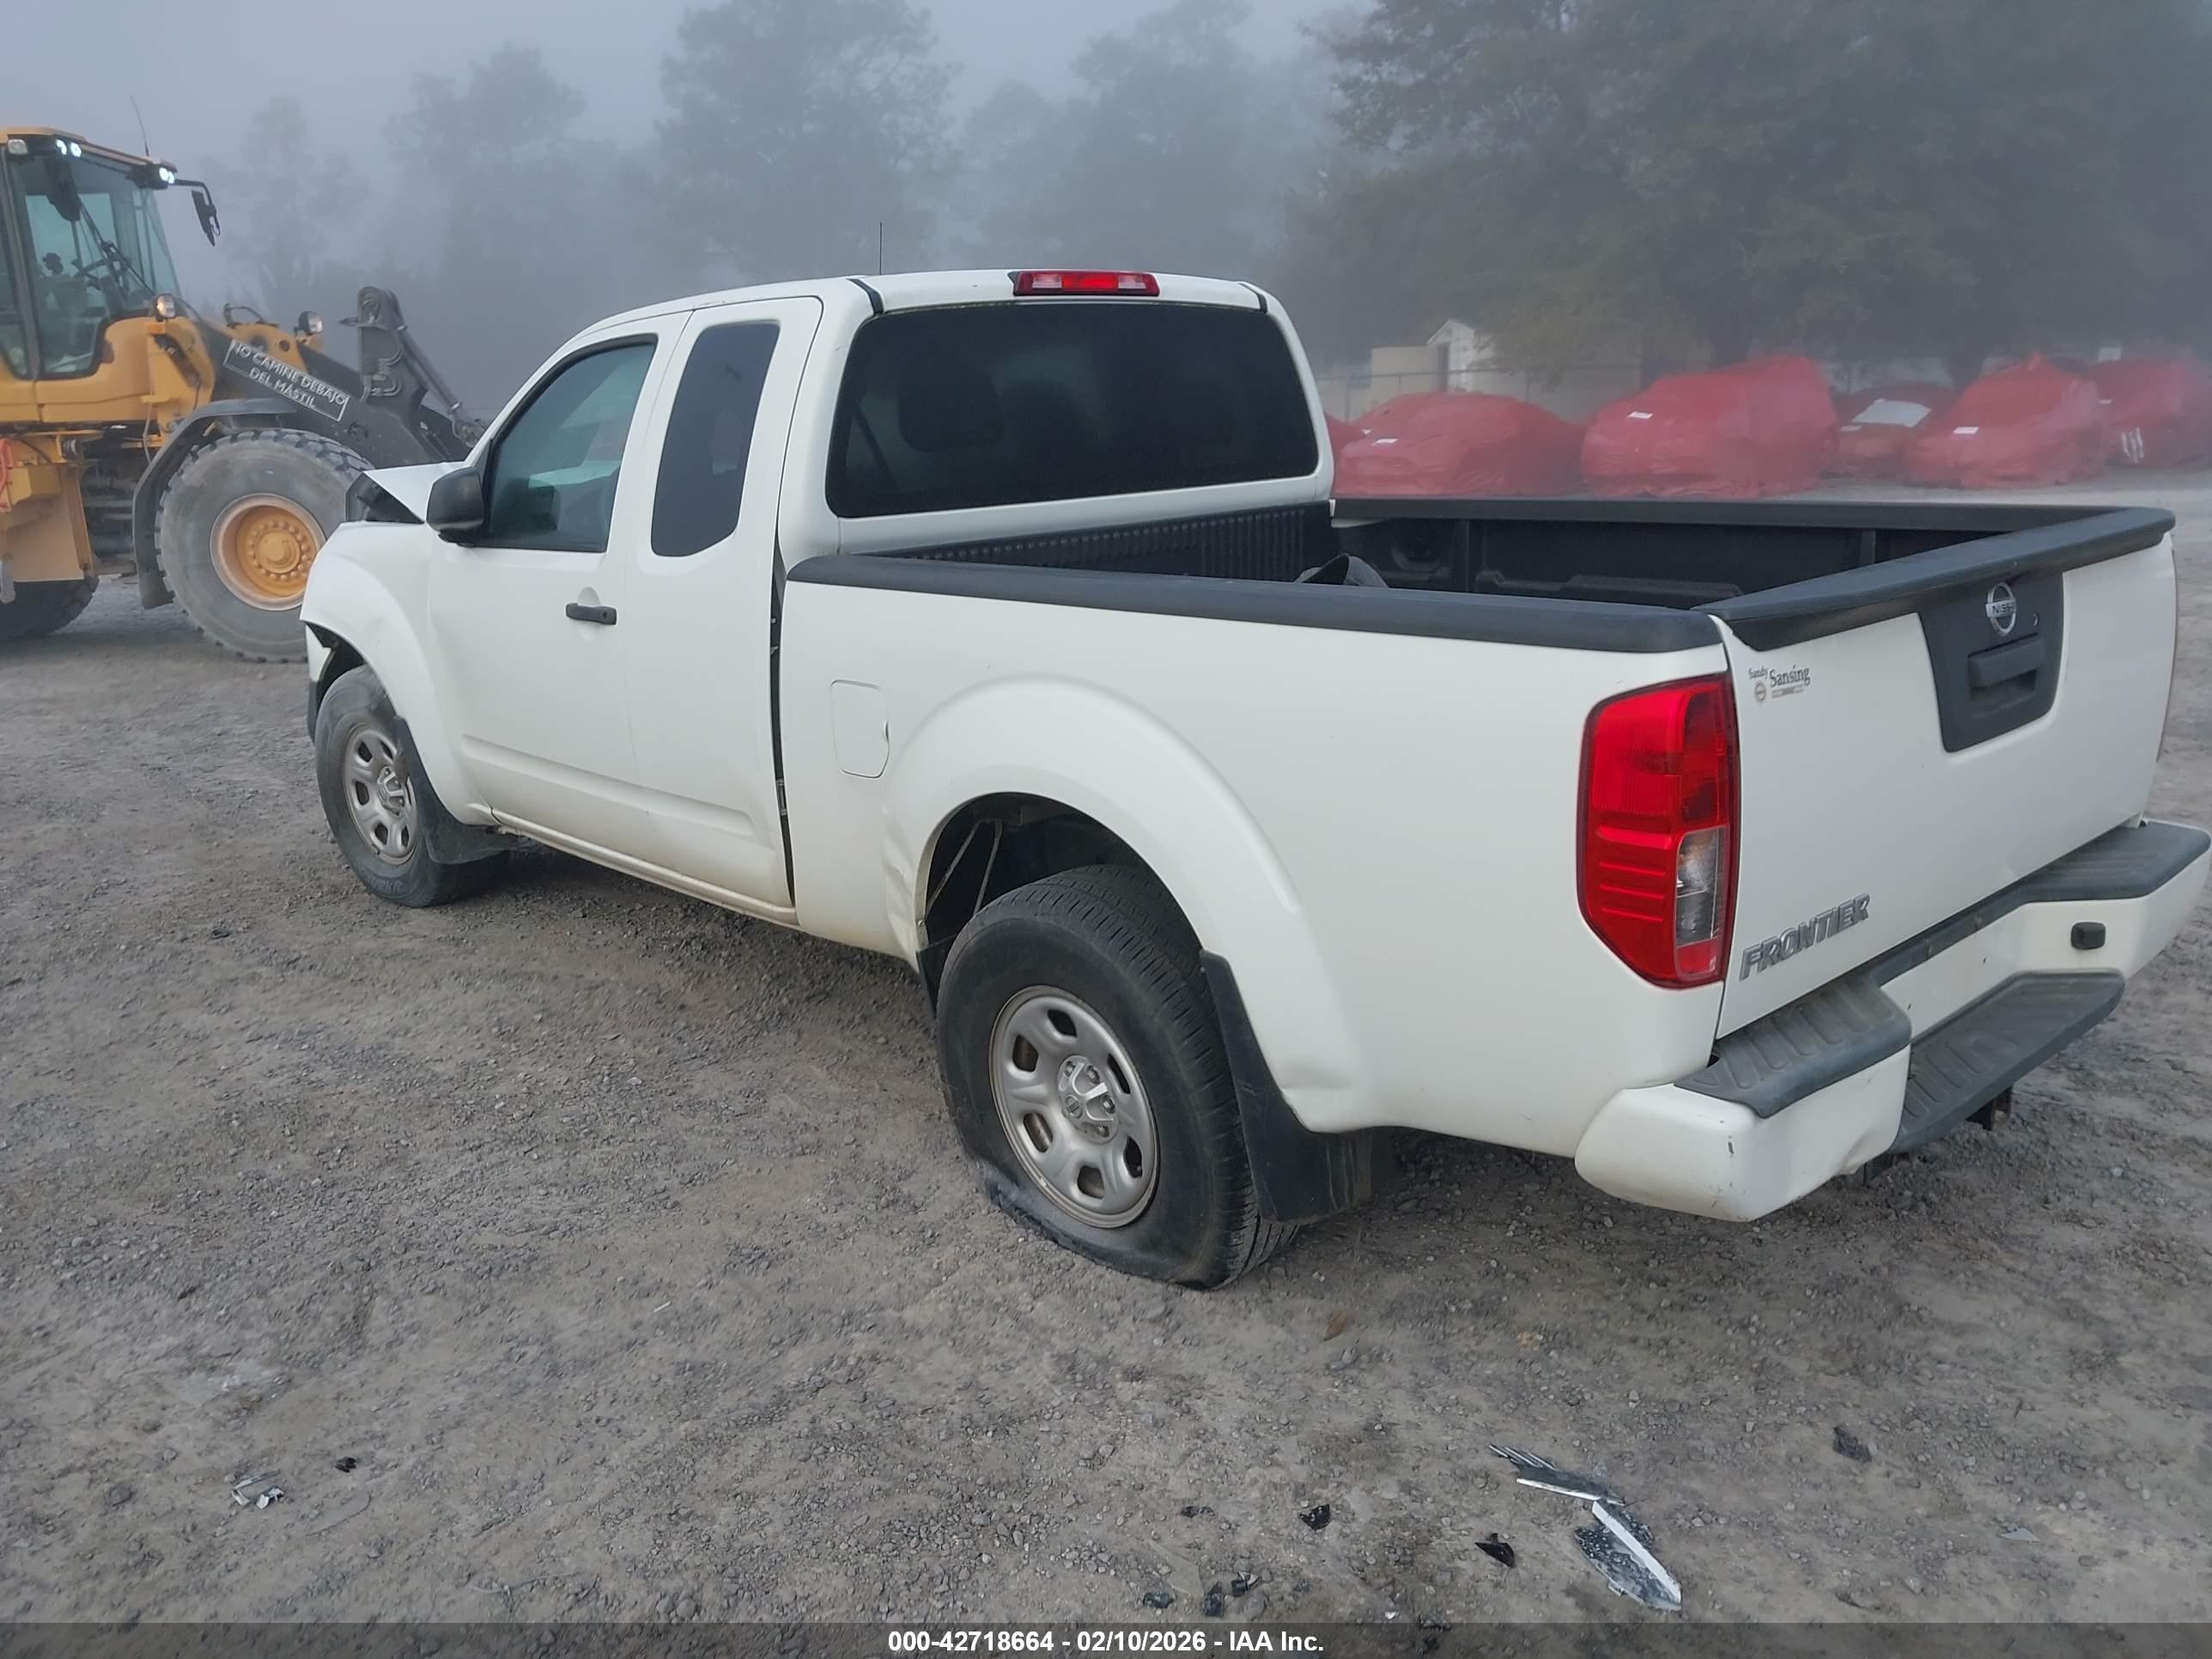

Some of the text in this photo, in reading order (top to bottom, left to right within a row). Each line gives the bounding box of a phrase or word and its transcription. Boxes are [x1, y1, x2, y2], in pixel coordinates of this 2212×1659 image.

[248, 367, 316, 408] DEL MÁSTIL
[252, 352, 299, 383] CAMINE
[301, 375, 346, 405] DEBAJO
[1769, 665, 1811, 688] Sansing
[1739, 892, 1870, 981] FRONTIER
